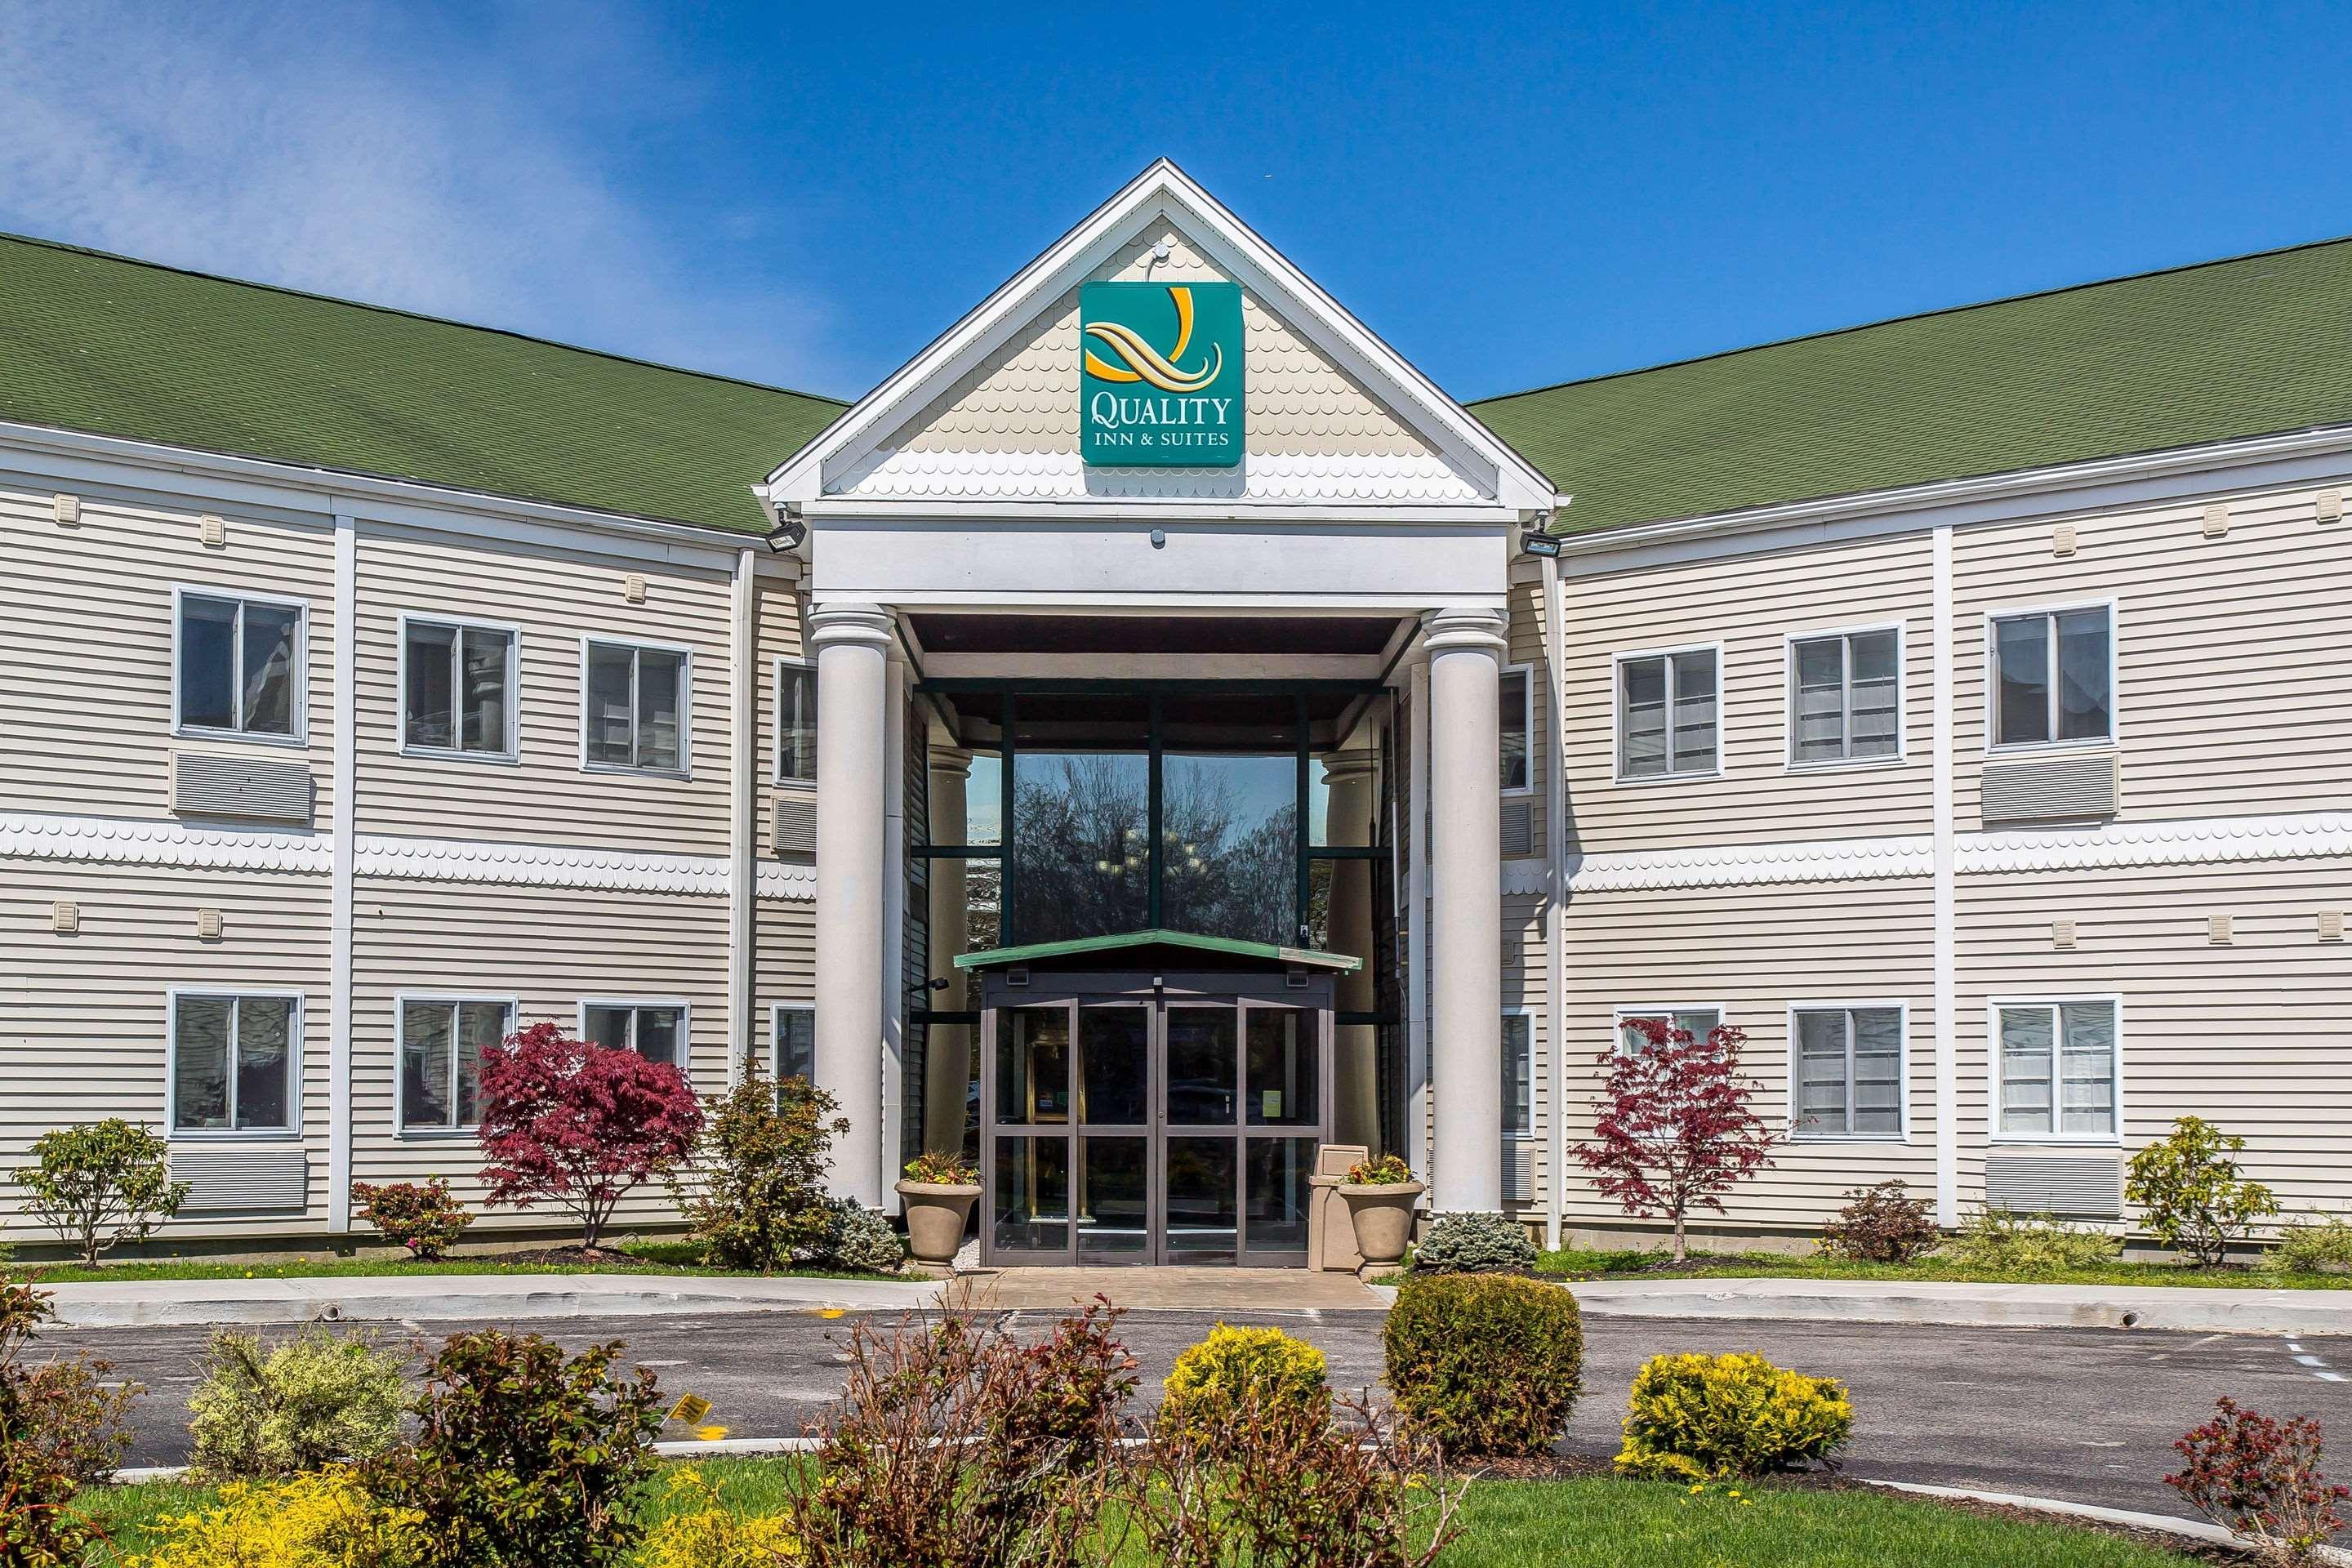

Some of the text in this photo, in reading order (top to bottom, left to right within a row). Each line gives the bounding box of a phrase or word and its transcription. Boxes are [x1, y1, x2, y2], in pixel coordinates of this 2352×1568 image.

[1091, 391, 1232, 429] QUALITY
[1095, 433, 1228, 445] INN & SUITES
